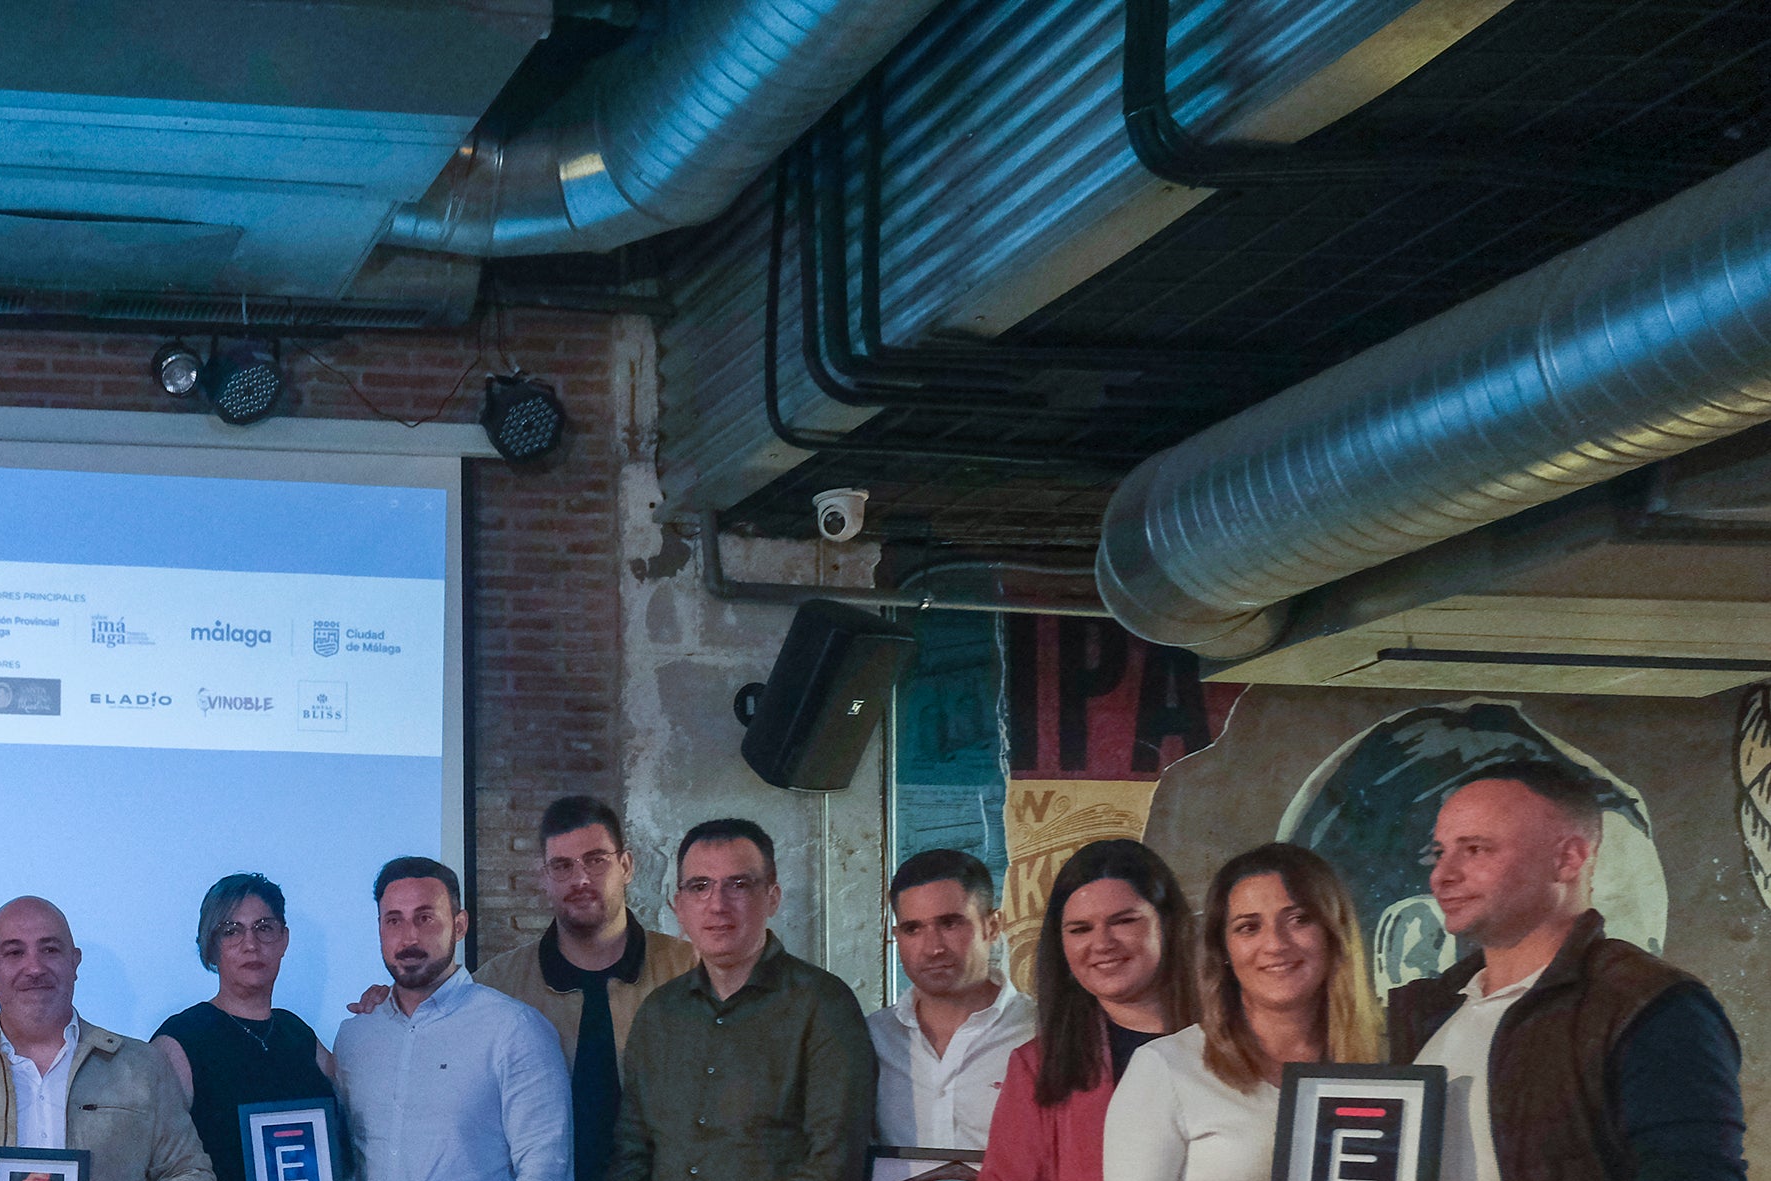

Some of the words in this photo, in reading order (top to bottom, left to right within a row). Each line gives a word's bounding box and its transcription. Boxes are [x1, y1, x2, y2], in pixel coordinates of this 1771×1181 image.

[23, 591, 86, 603] PRINCIPALES
[14, 616, 59, 627] Provincial
[345, 628, 385, 640] Ciudad
[345, 642, 360, 652] de
[362, 642, 401, 655] Málaga
[207, 695, 275, 712] VINOBLE
[303, 709, 342, 720] BLISS
